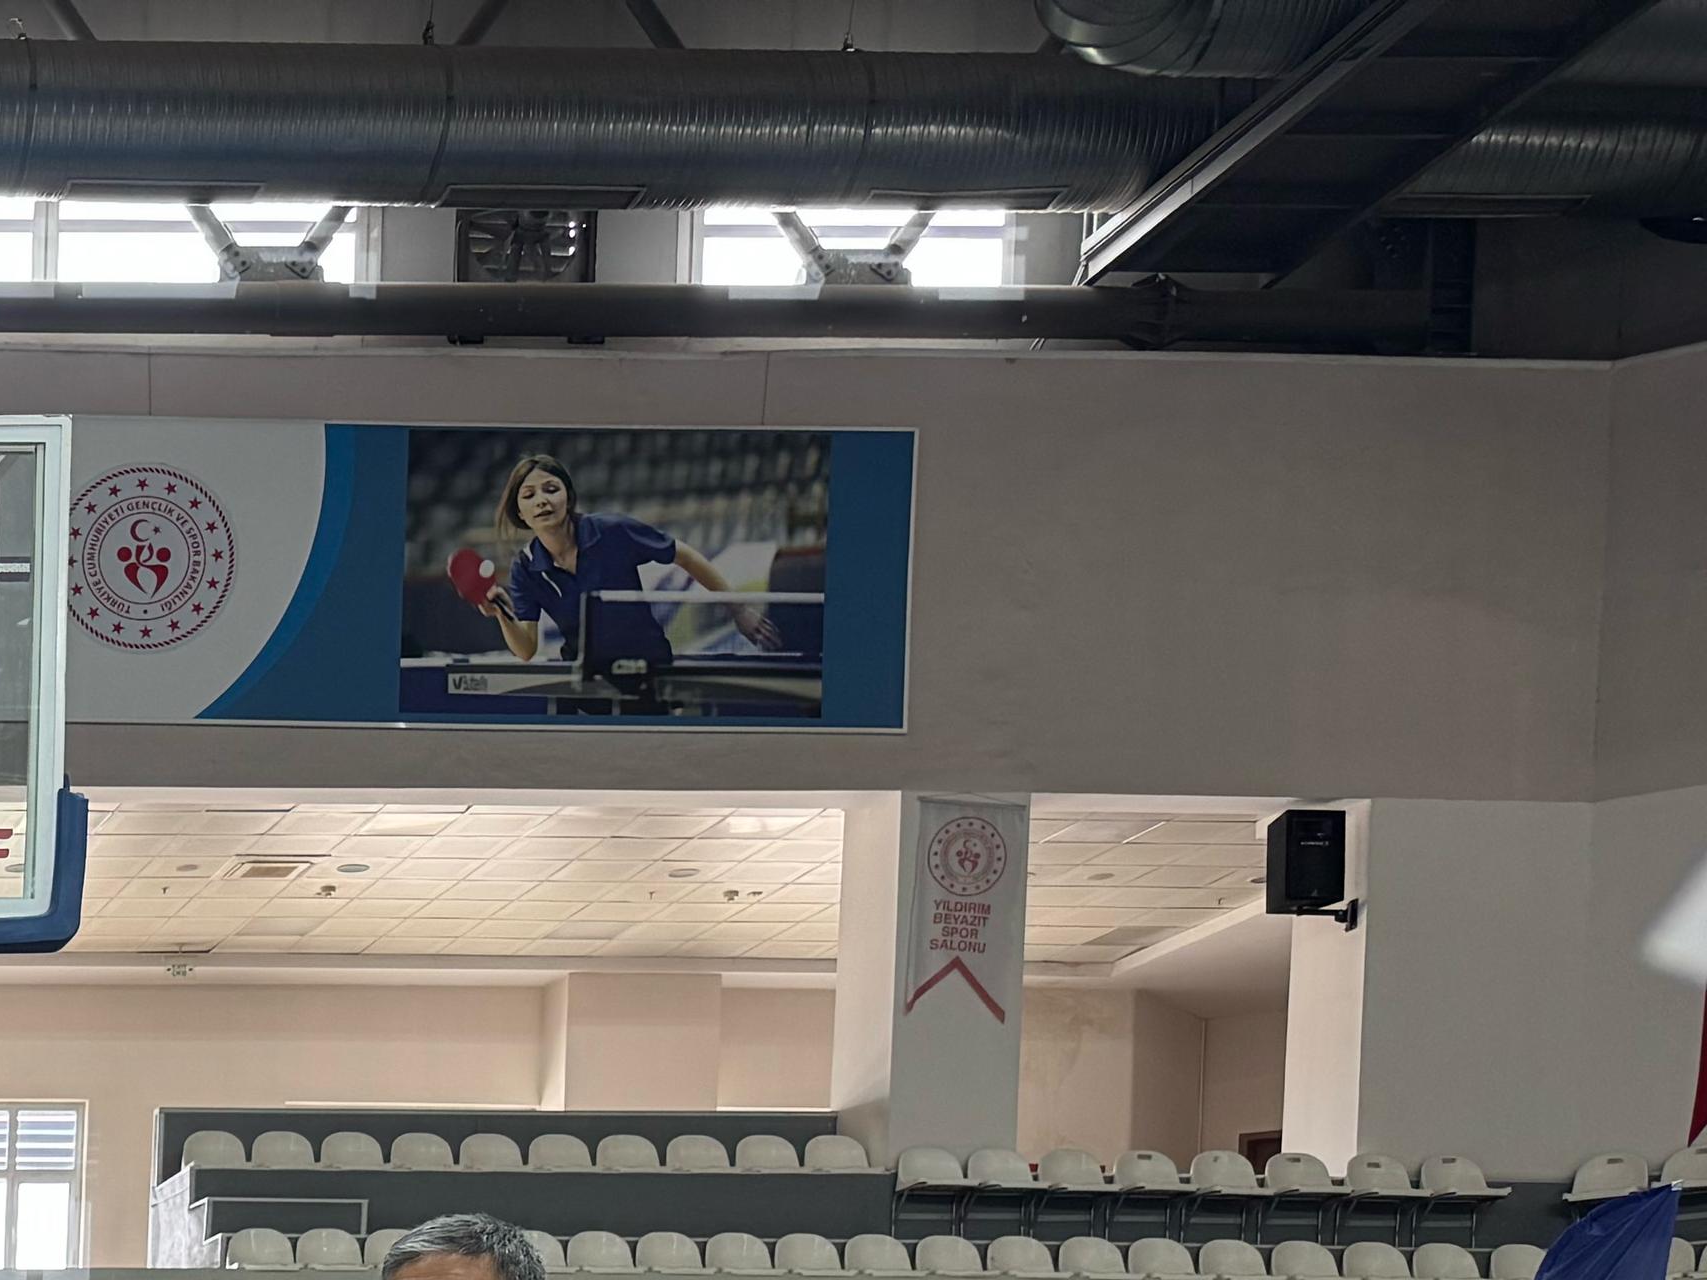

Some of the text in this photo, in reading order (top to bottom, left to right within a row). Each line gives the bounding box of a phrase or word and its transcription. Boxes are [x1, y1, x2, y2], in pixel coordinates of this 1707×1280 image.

[186, 528, 201, 556] SPOR
[933, 899, 991, 915] YILDIRIM
[932, 913, 989, 928] BEYAZIT
[941, 926, 979, 939] SPOR
[929, 939, 986, 954] SALONU
